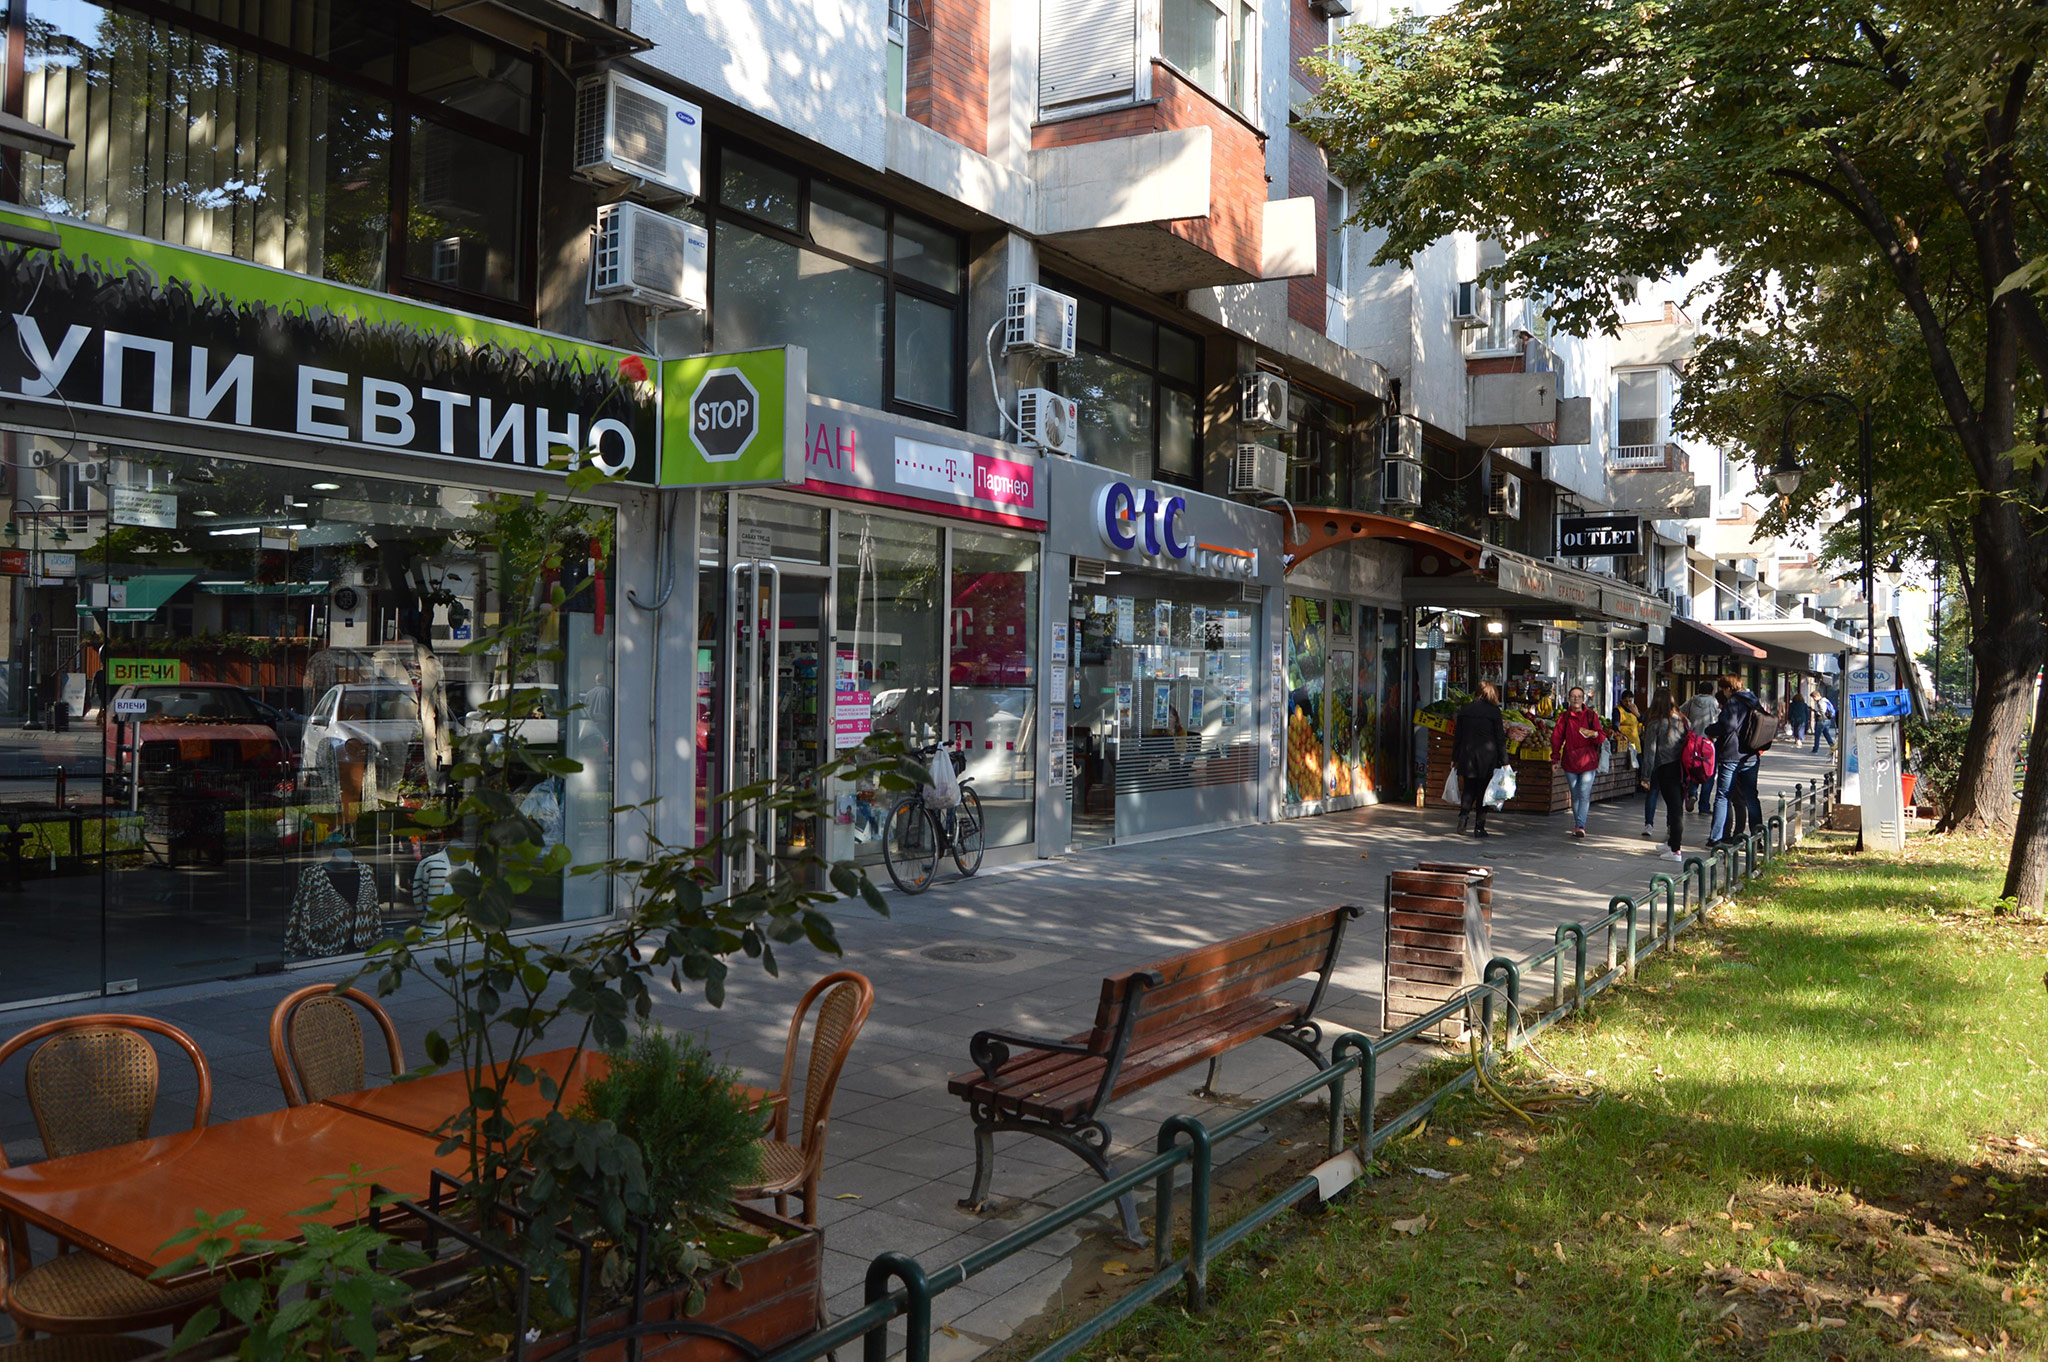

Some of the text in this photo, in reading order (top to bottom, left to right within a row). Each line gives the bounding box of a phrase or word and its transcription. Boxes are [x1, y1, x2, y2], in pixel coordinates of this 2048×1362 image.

[0, 310, 636, 478] УПИ ЕВТИНО
[697, 399, 749, 431] STOP
[805, 422, 855, 472] АН
[977, 466, 1029, 501] Партнер
[1099, 482, 1188, 559] etc
[1564, 530, 1635, 547] OUTLET
[1188, 536, 1258, 577] travel
[1558, 585, 1586, 602] БРАТСТВО
[115, 665, 174, 679] ВЛЕЧИ
[1853, 671, 1885, 680] GORKA
